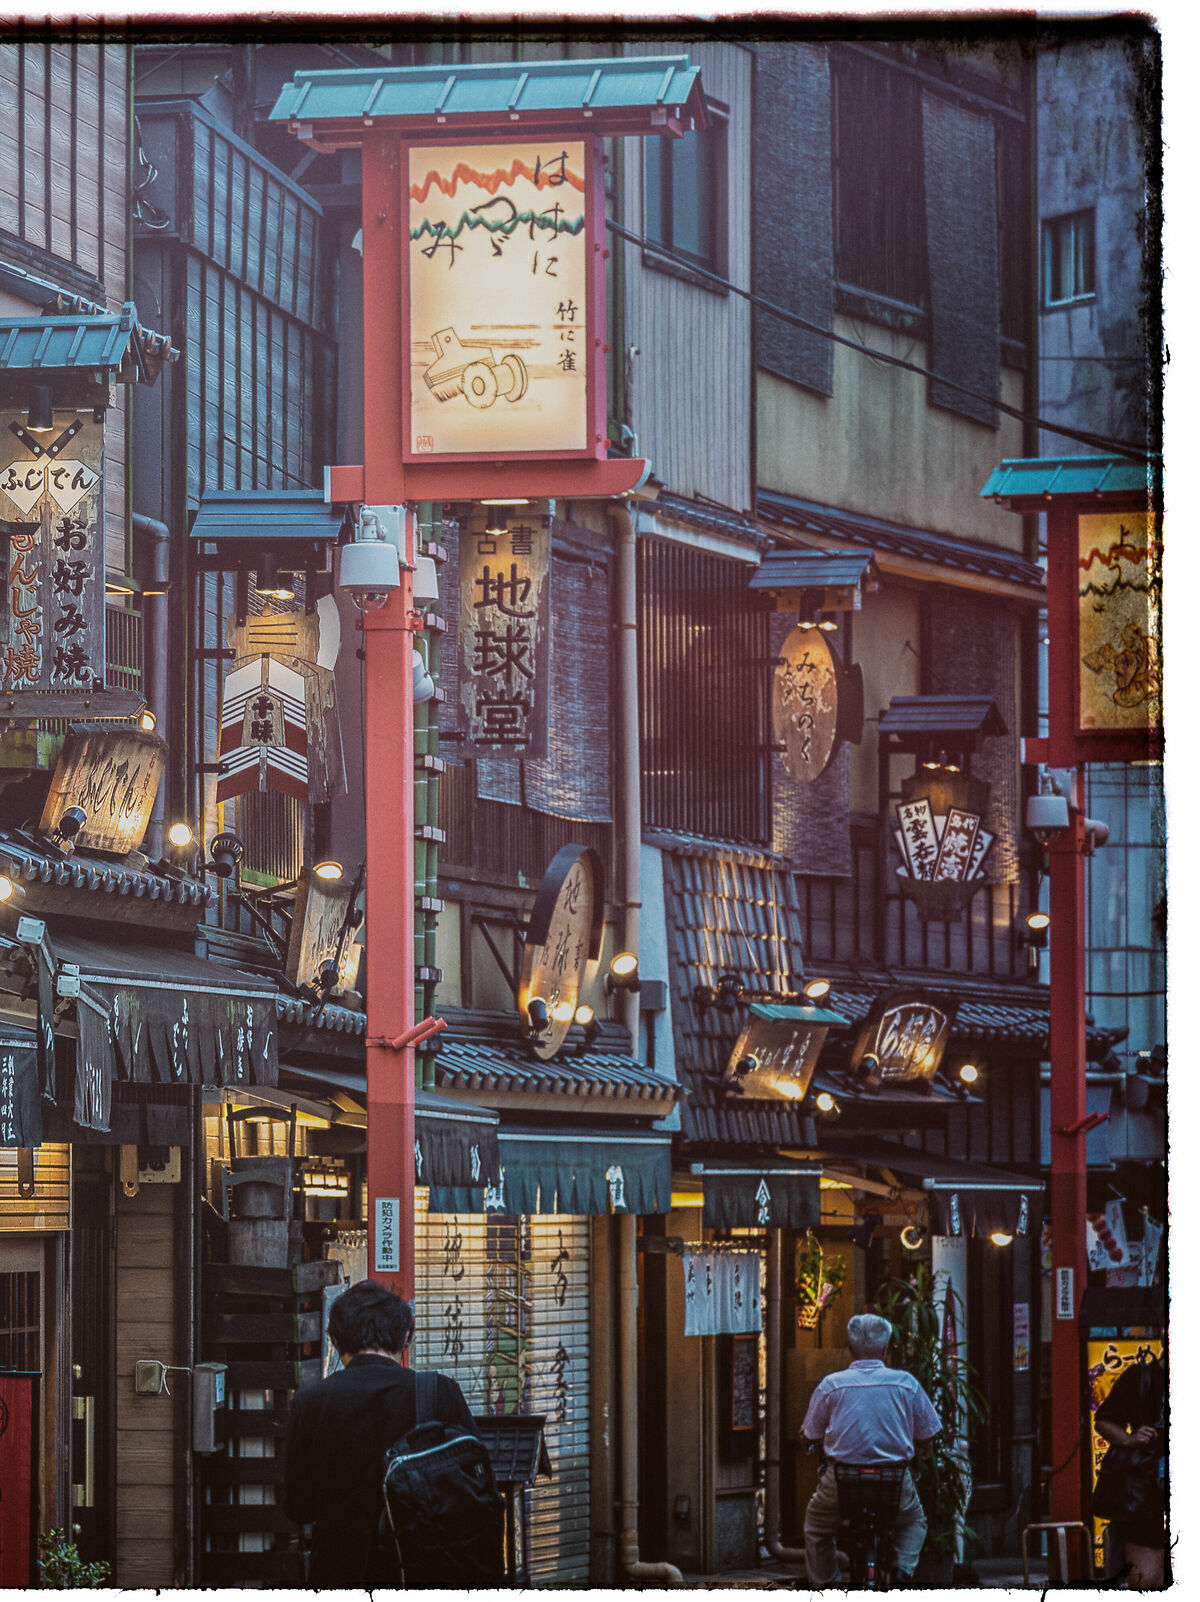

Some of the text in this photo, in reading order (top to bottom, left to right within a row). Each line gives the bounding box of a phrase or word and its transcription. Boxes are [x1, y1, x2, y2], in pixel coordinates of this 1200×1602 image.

[557, 299, 578, 372] 竹に雀
[1, 466, 93, 491] ふじでん
[472, 524, 538, 555] 古書
[3, 517, 42, 682] もんじゃ焼
[52, 516, 91, 682] お好み焼
[473, 562, 535, 745] 地球堂
[796, 651, 817, 762] みちのく
[381, 1201, 393, 1262] 防犯カメラ作動中
[1103, 1344, 1165, 1371] らーめ
